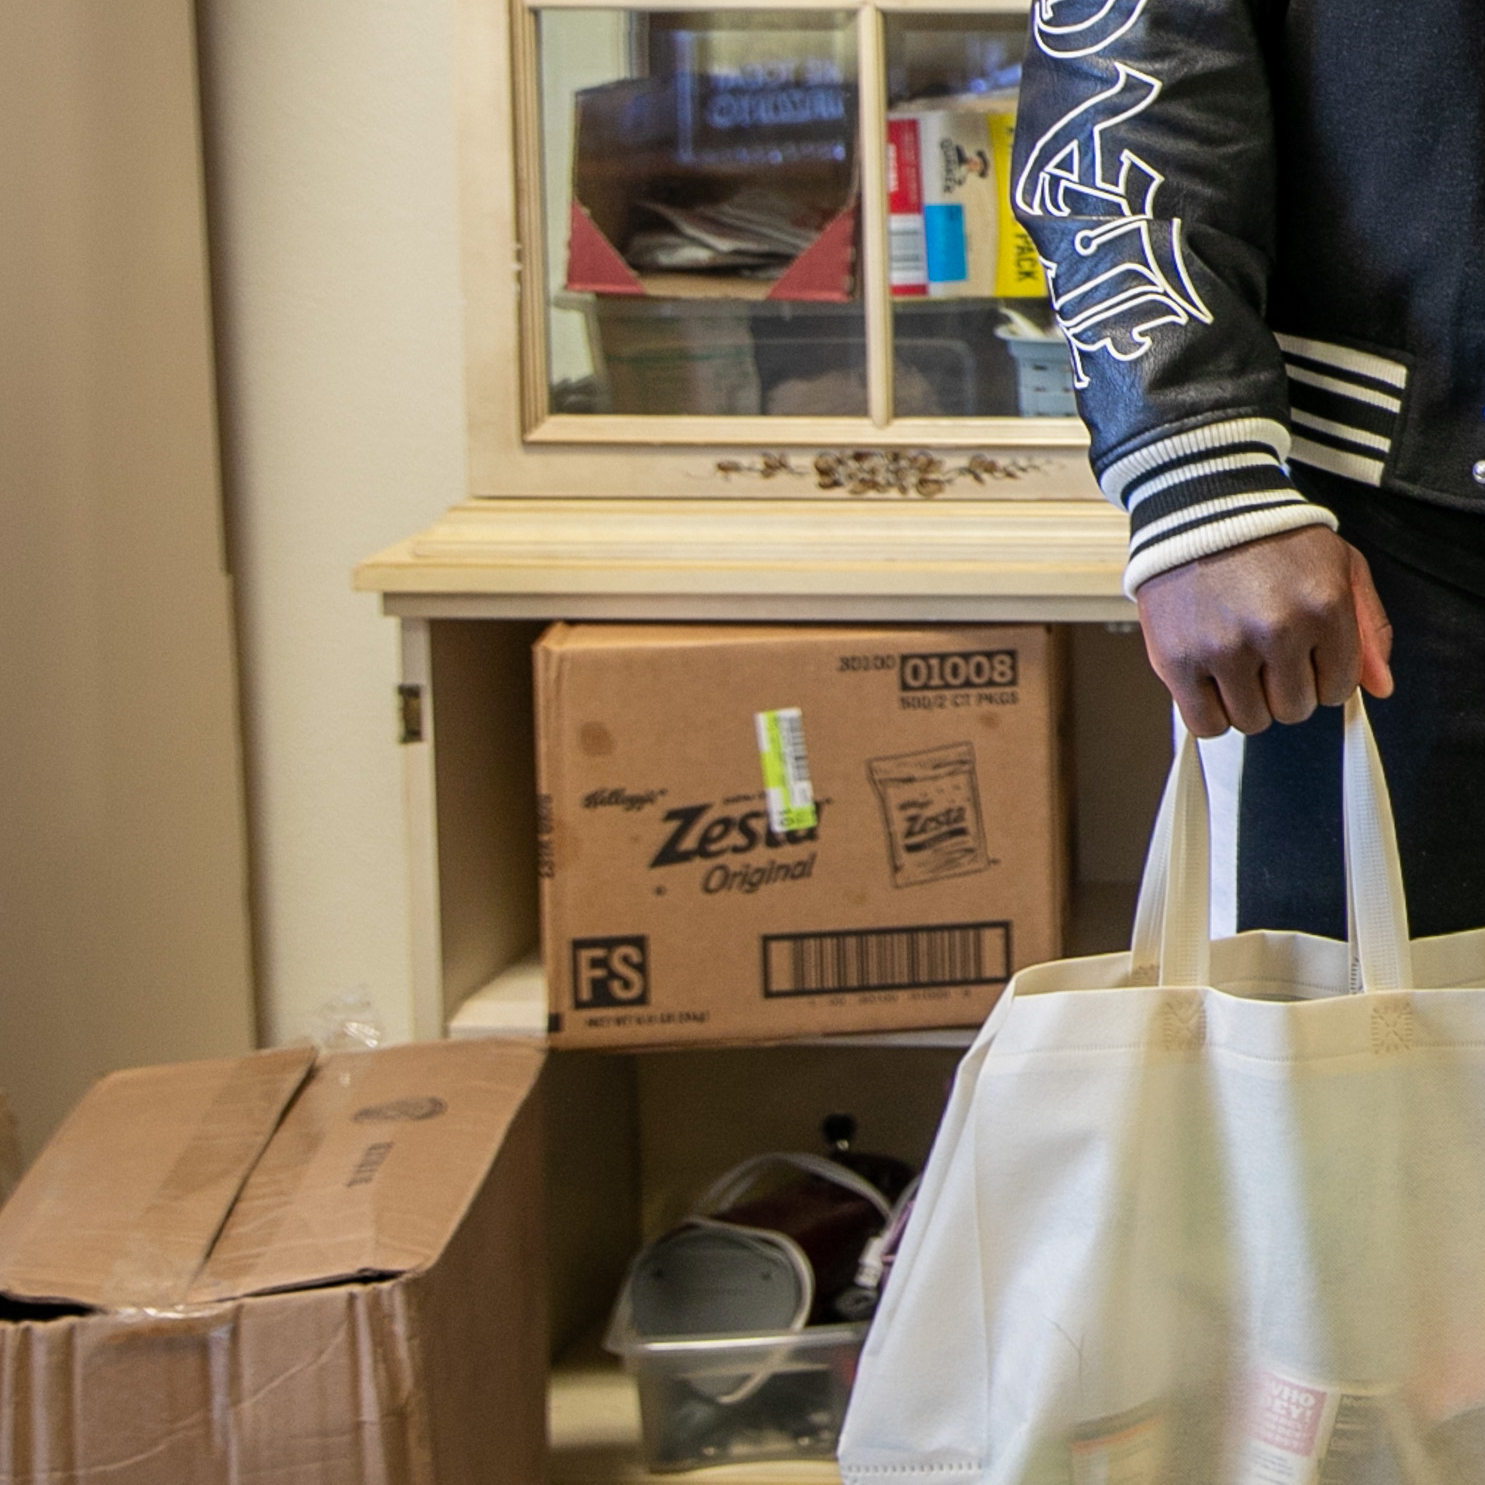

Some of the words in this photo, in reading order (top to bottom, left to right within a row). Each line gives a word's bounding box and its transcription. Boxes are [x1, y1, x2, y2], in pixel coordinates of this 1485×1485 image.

[1015, 232, 1037, 282] PACK
[902, 655, 1014, 689] 01008
[904, 806, 966, 839] Zesta
[702, 853, 815, 894] Original
[578, 944, 646, 1002] FS
